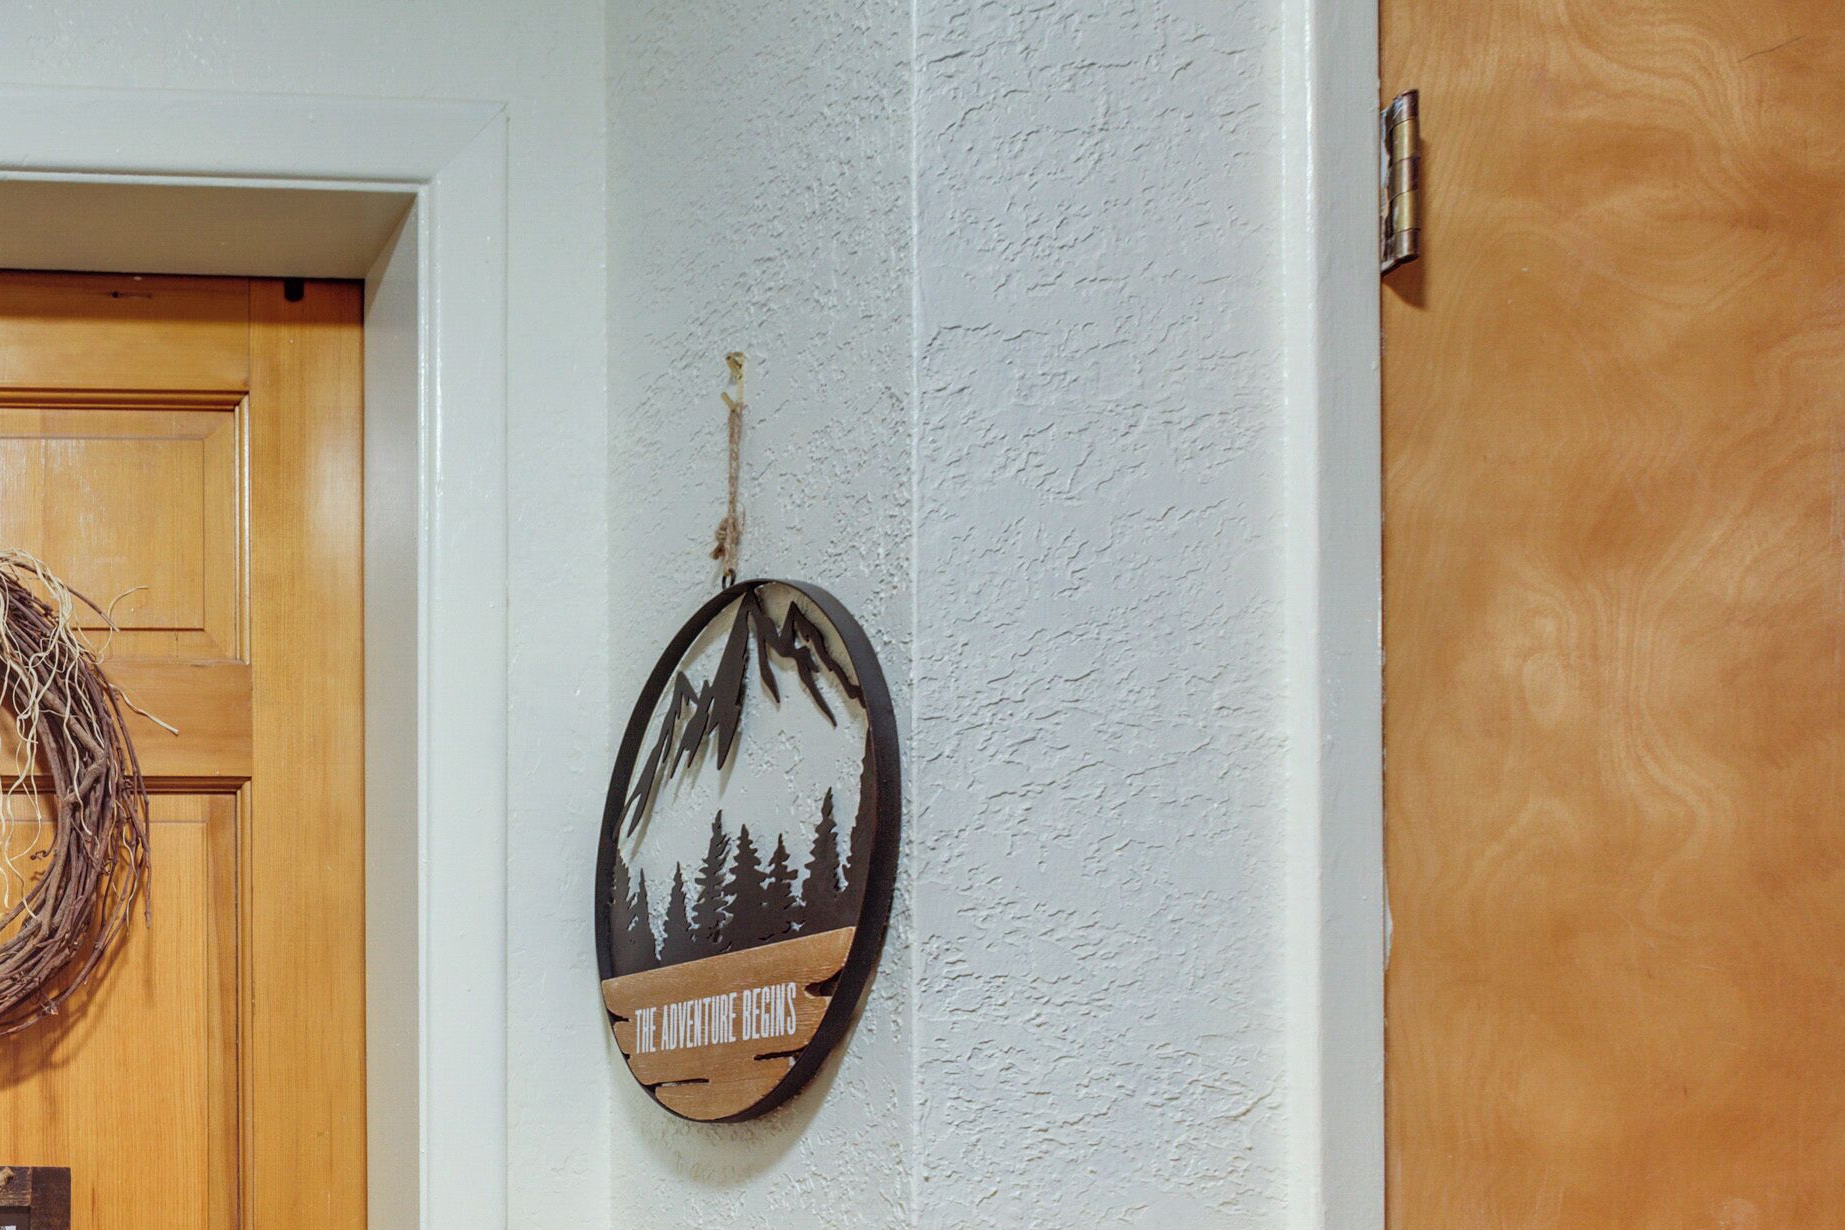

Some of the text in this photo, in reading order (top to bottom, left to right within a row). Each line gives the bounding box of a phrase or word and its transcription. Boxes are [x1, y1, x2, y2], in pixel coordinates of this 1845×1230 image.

[635, 982, 796, 1054] THE ADVENTURE BEGINS
